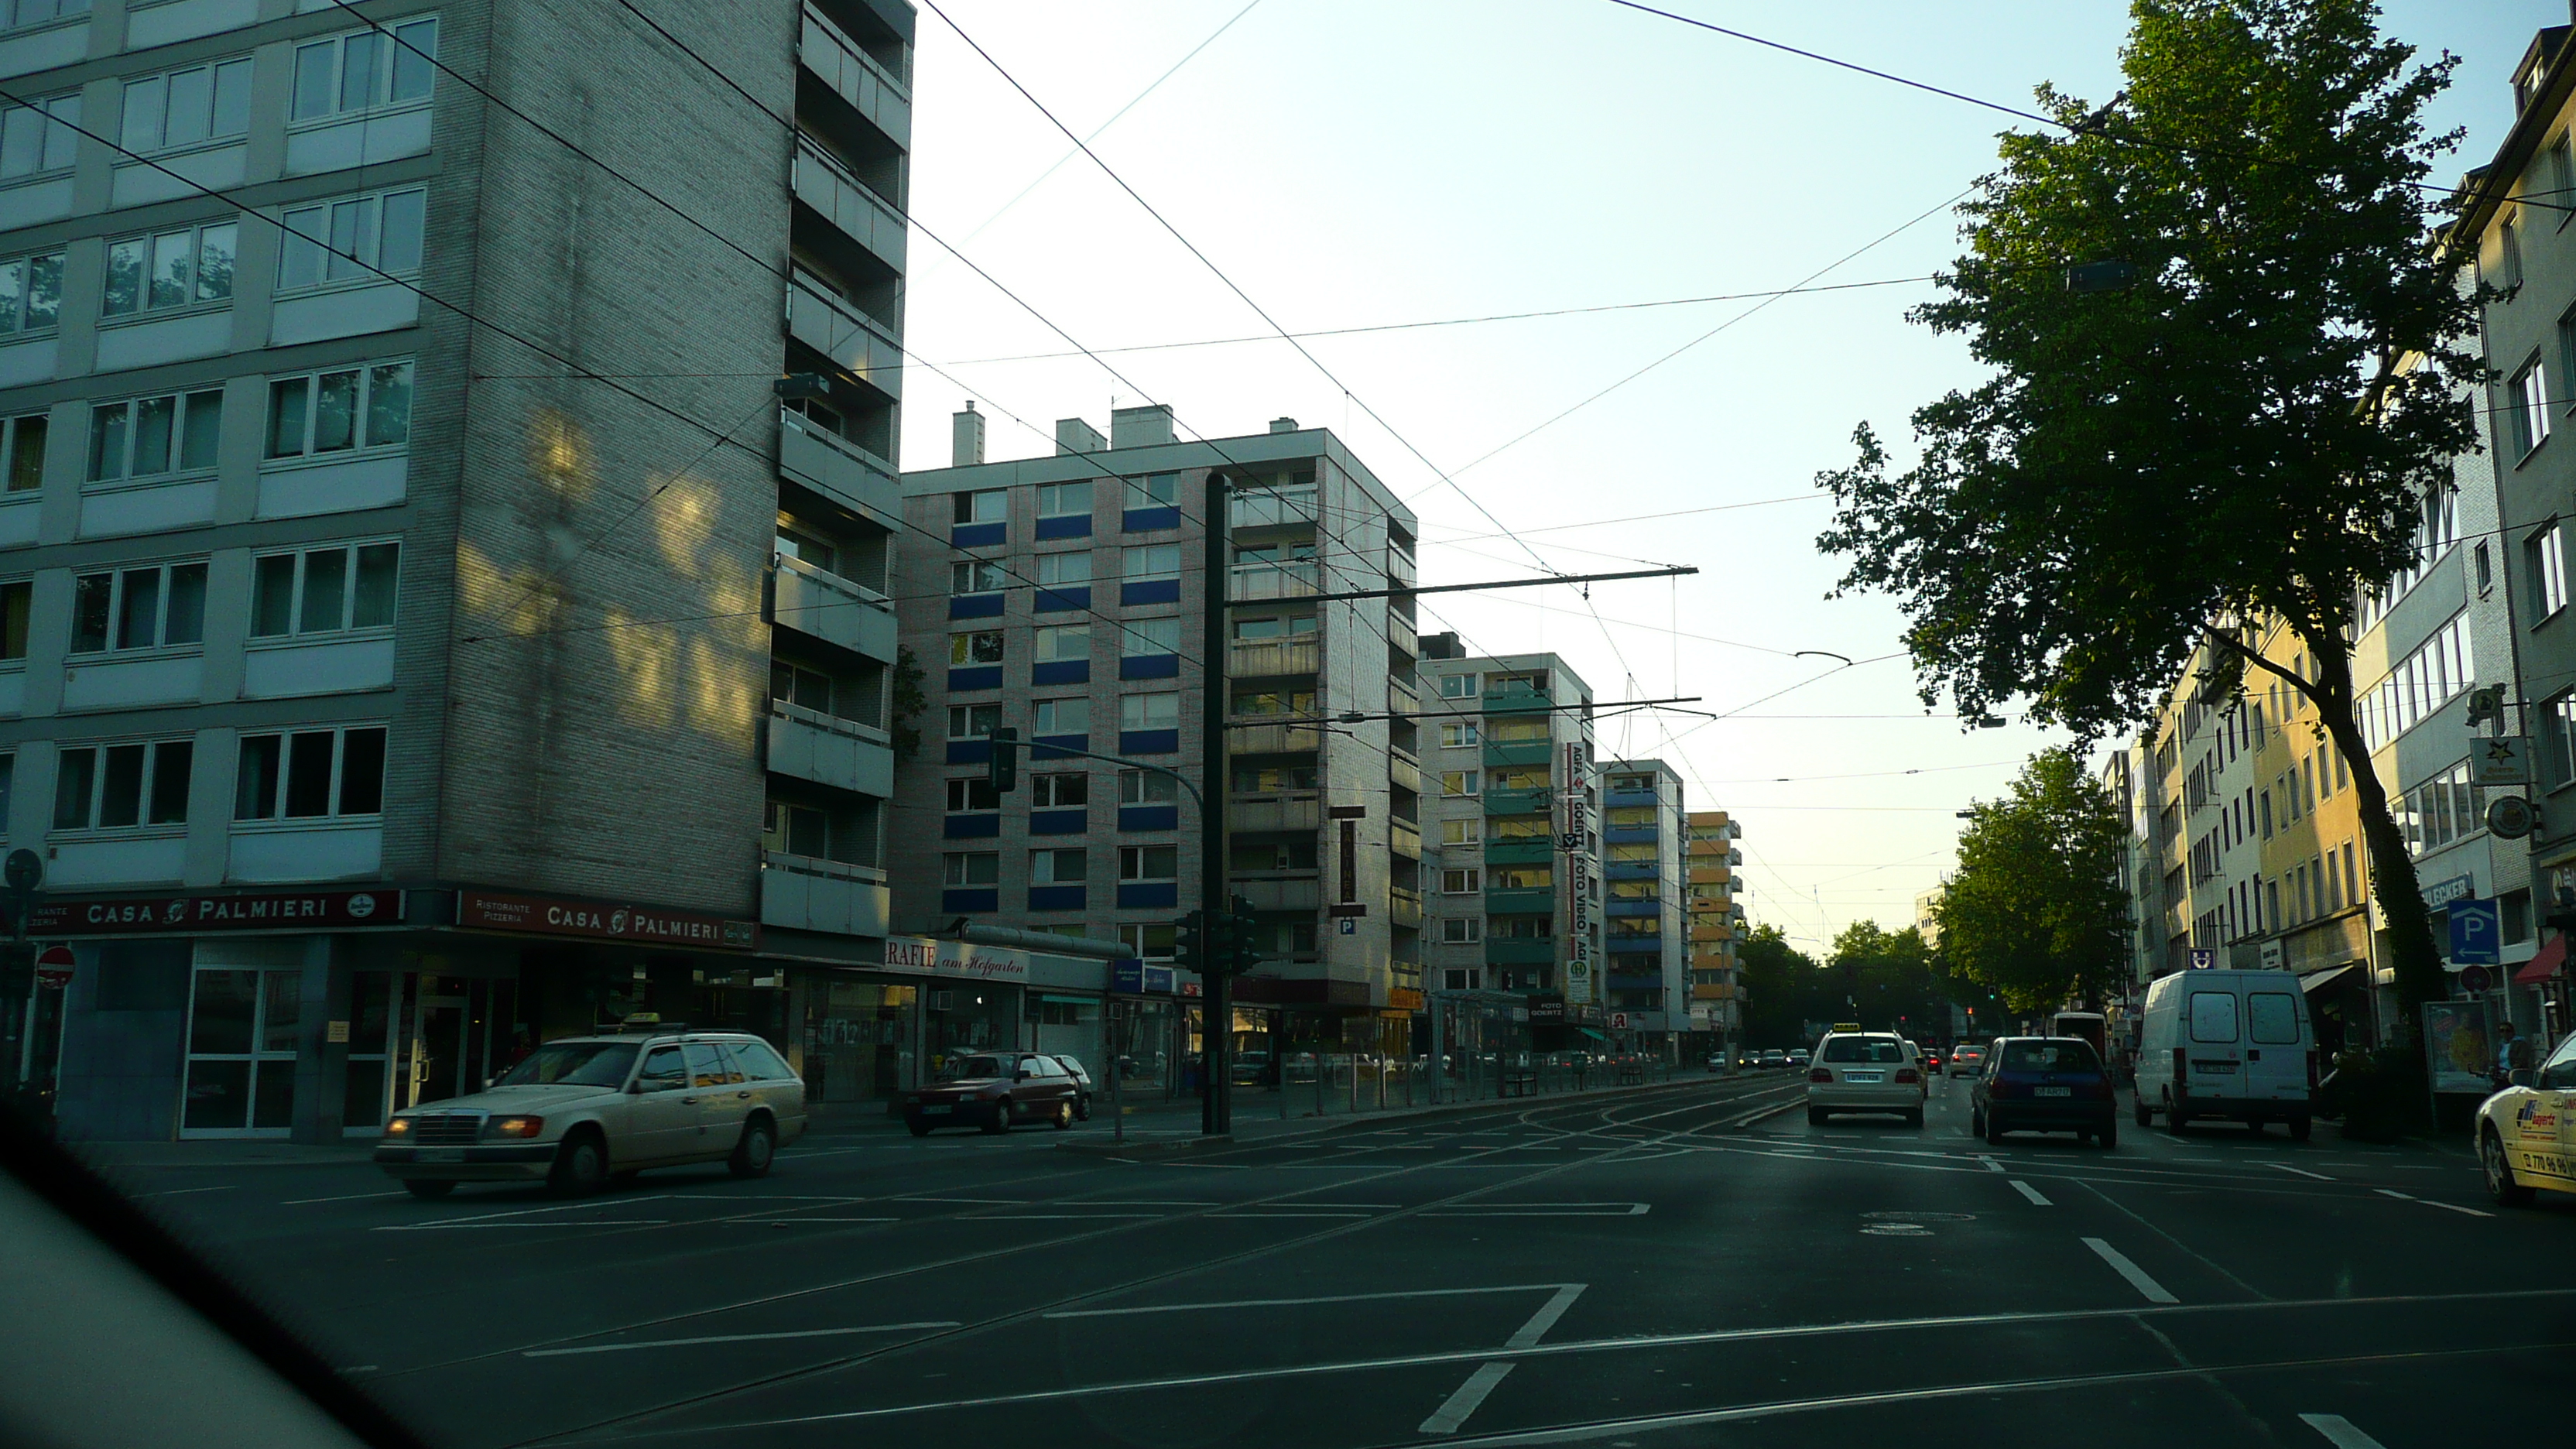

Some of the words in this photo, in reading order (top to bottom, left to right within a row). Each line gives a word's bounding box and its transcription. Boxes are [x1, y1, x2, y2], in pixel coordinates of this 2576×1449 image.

[1574, 747, 1583, 774] AGFA
[1576, 858, 1585, 890] FOTO
[37, 907, 68, 916] RANTE
[87, 904, 153, 923] CASA
[198, 899, 327, 920] PALMIERI
[547, 906, 601, 929] CASA
[635, 915, 718, 940] PALMIERI
[1577, 894, 1586, 930] VIDEO
[1342, 921, 1352, 933] P
[2464, 917, 2485, 941] P
[886, 942, 937, 968] RAFIE
[942, 958, 962, 968] am
[965, 956, 1024, 977] Hofgarten
